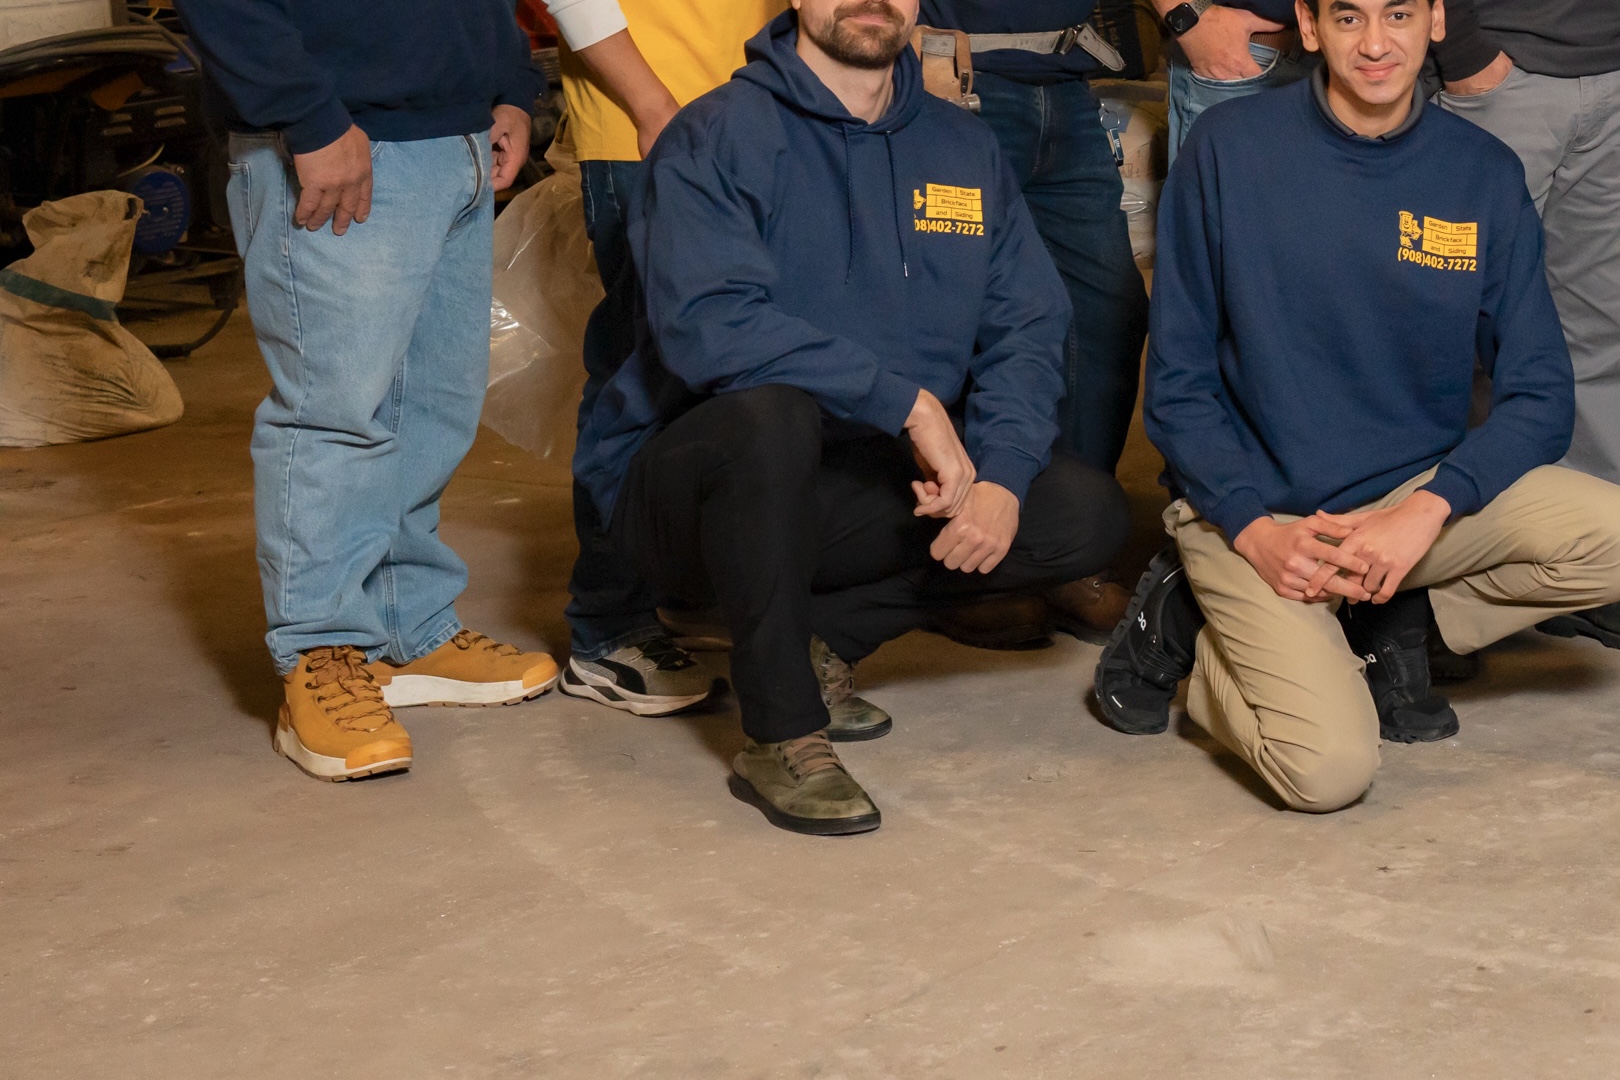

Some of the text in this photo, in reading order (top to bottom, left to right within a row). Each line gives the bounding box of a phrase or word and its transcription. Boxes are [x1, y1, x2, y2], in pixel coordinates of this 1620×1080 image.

[941, 199, 967, 207] Brickface
[955, 212, 973, 220] Siding
[914, 219, 985, 236] 08)402-7272
[1429, 221, 1448, 230] Garden
[1436, 235, 1462, 243] Brickface
[1397, 247, 1477, 271] (908)402-7272
